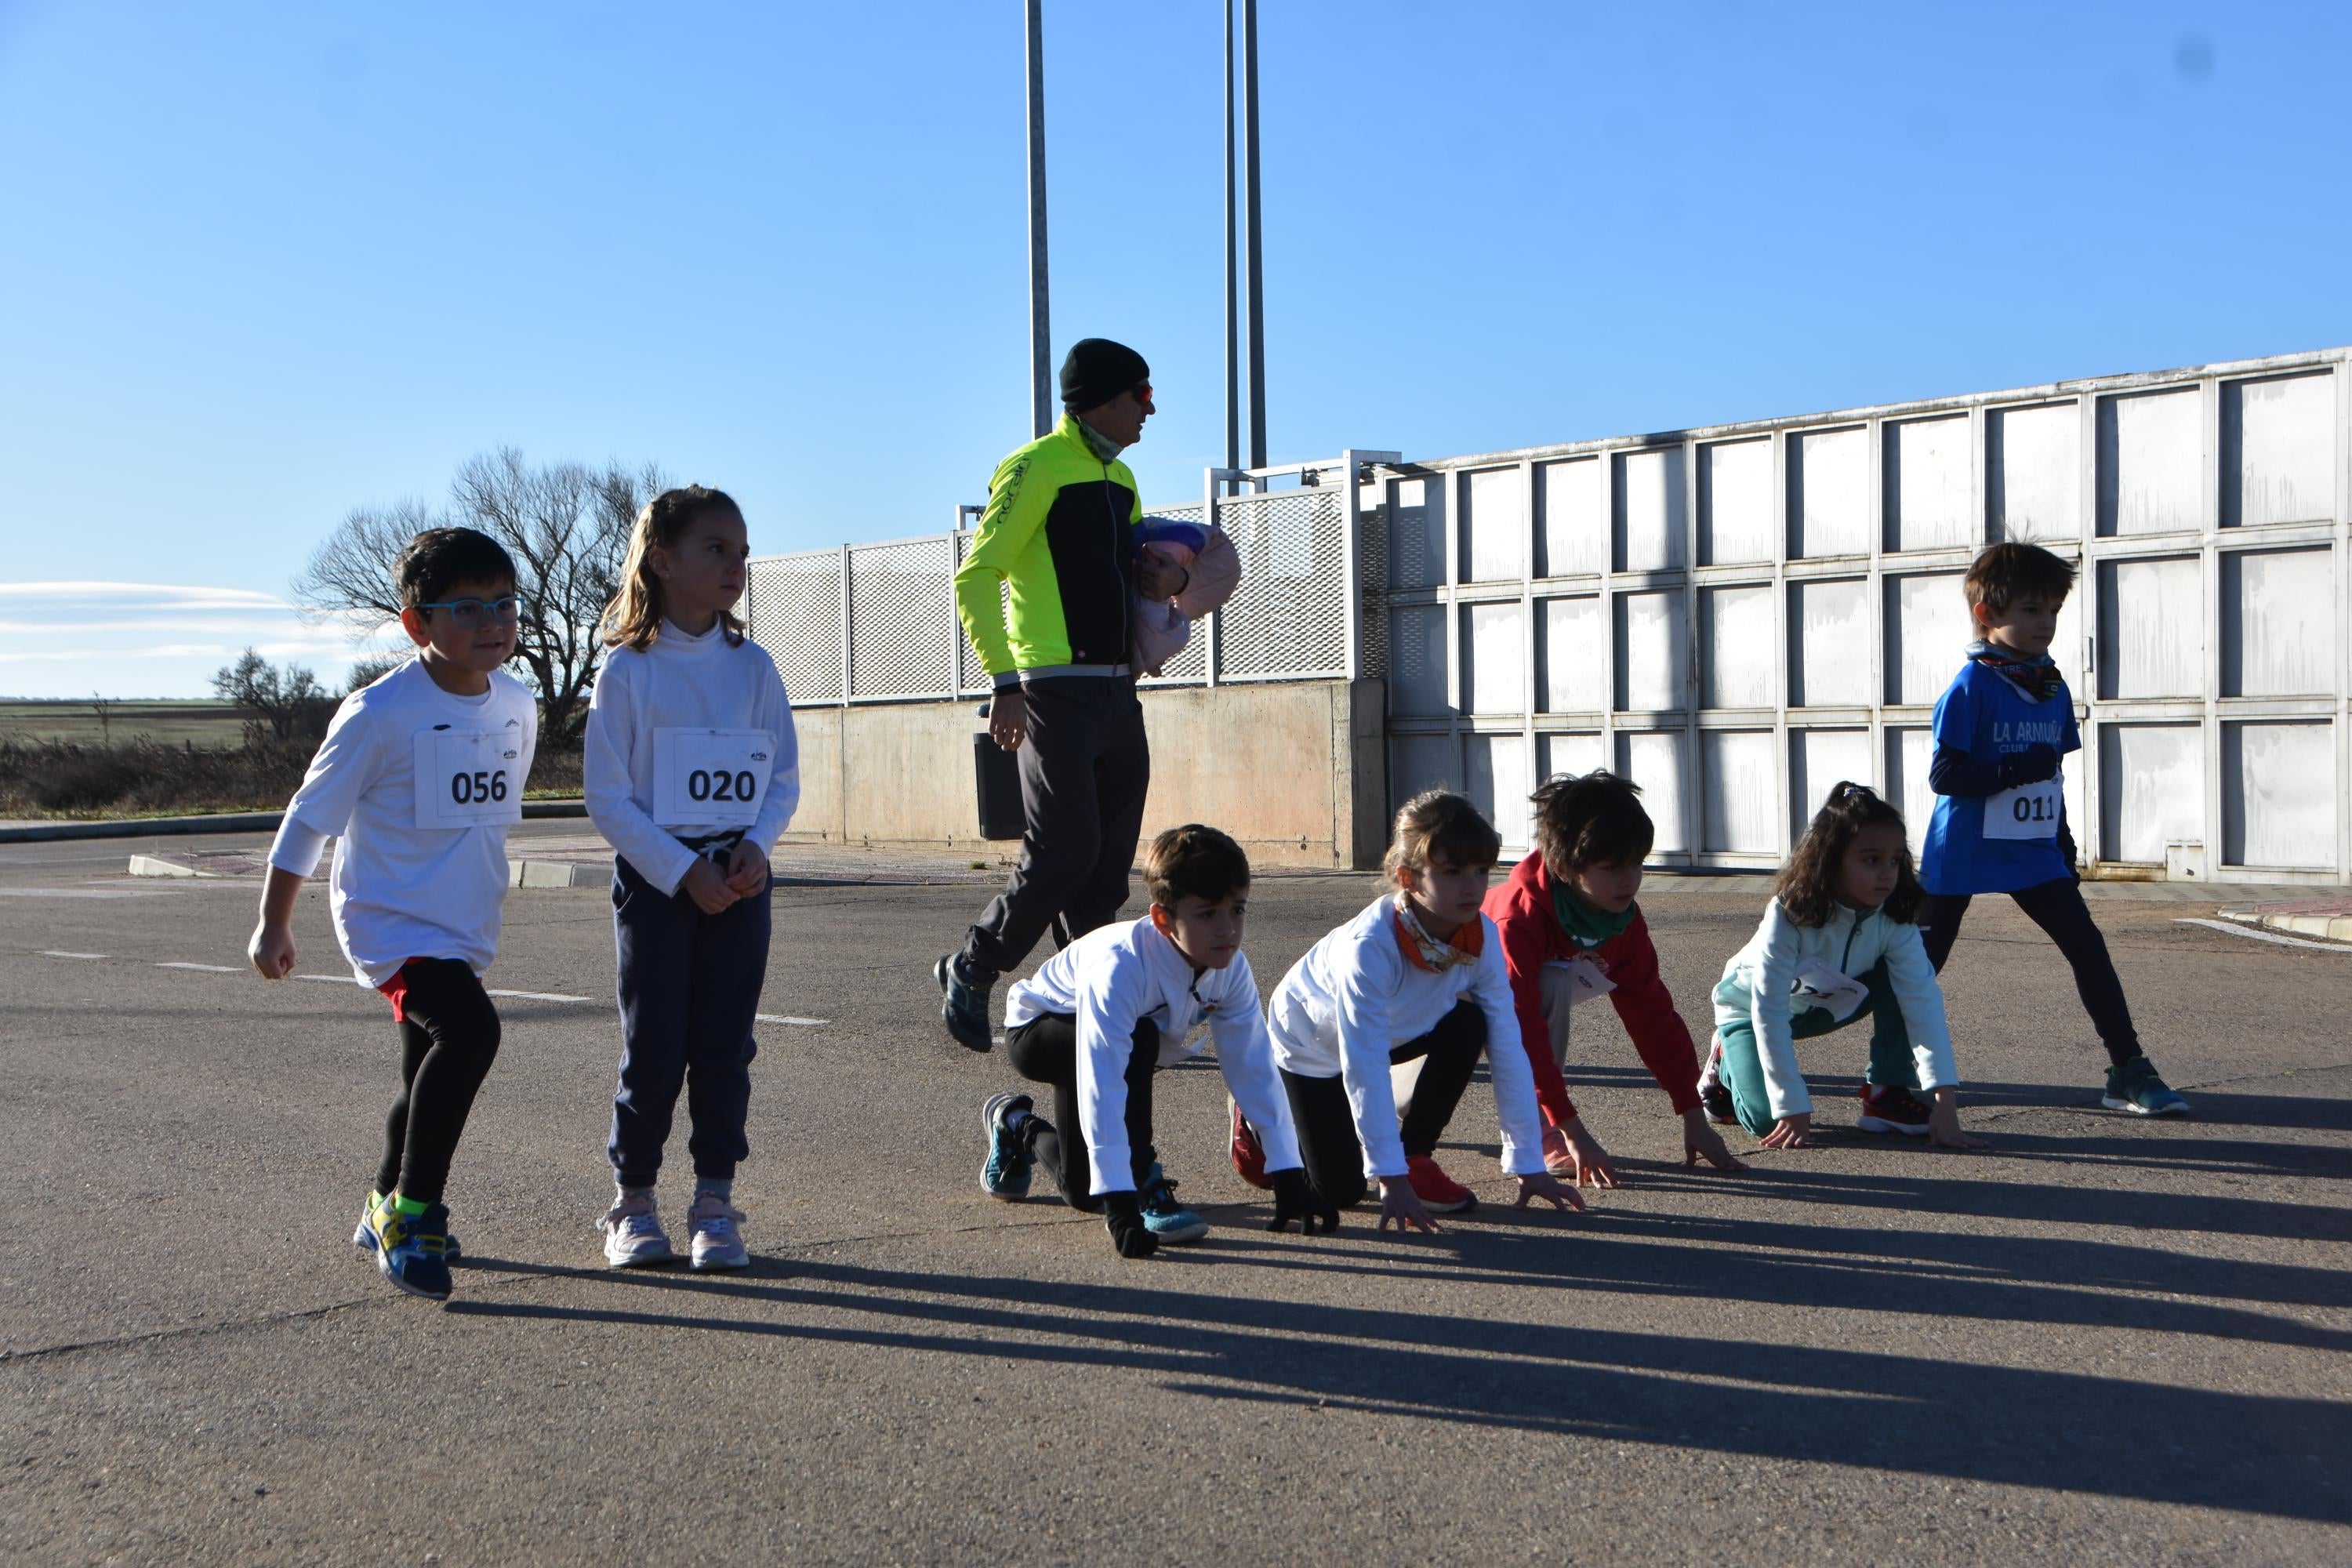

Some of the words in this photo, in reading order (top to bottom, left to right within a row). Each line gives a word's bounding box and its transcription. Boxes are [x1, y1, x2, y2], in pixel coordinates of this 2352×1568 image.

[1993, 721, 2011, 742] LA
[2016, 719, 2063, 744] ARMUÑA
[1998, 743, 2024, 753] CLUB
[451, 770, 507, 804] 056
[688, 769, 756, 803] 020
[2013, 795, 2054, 822] 011
